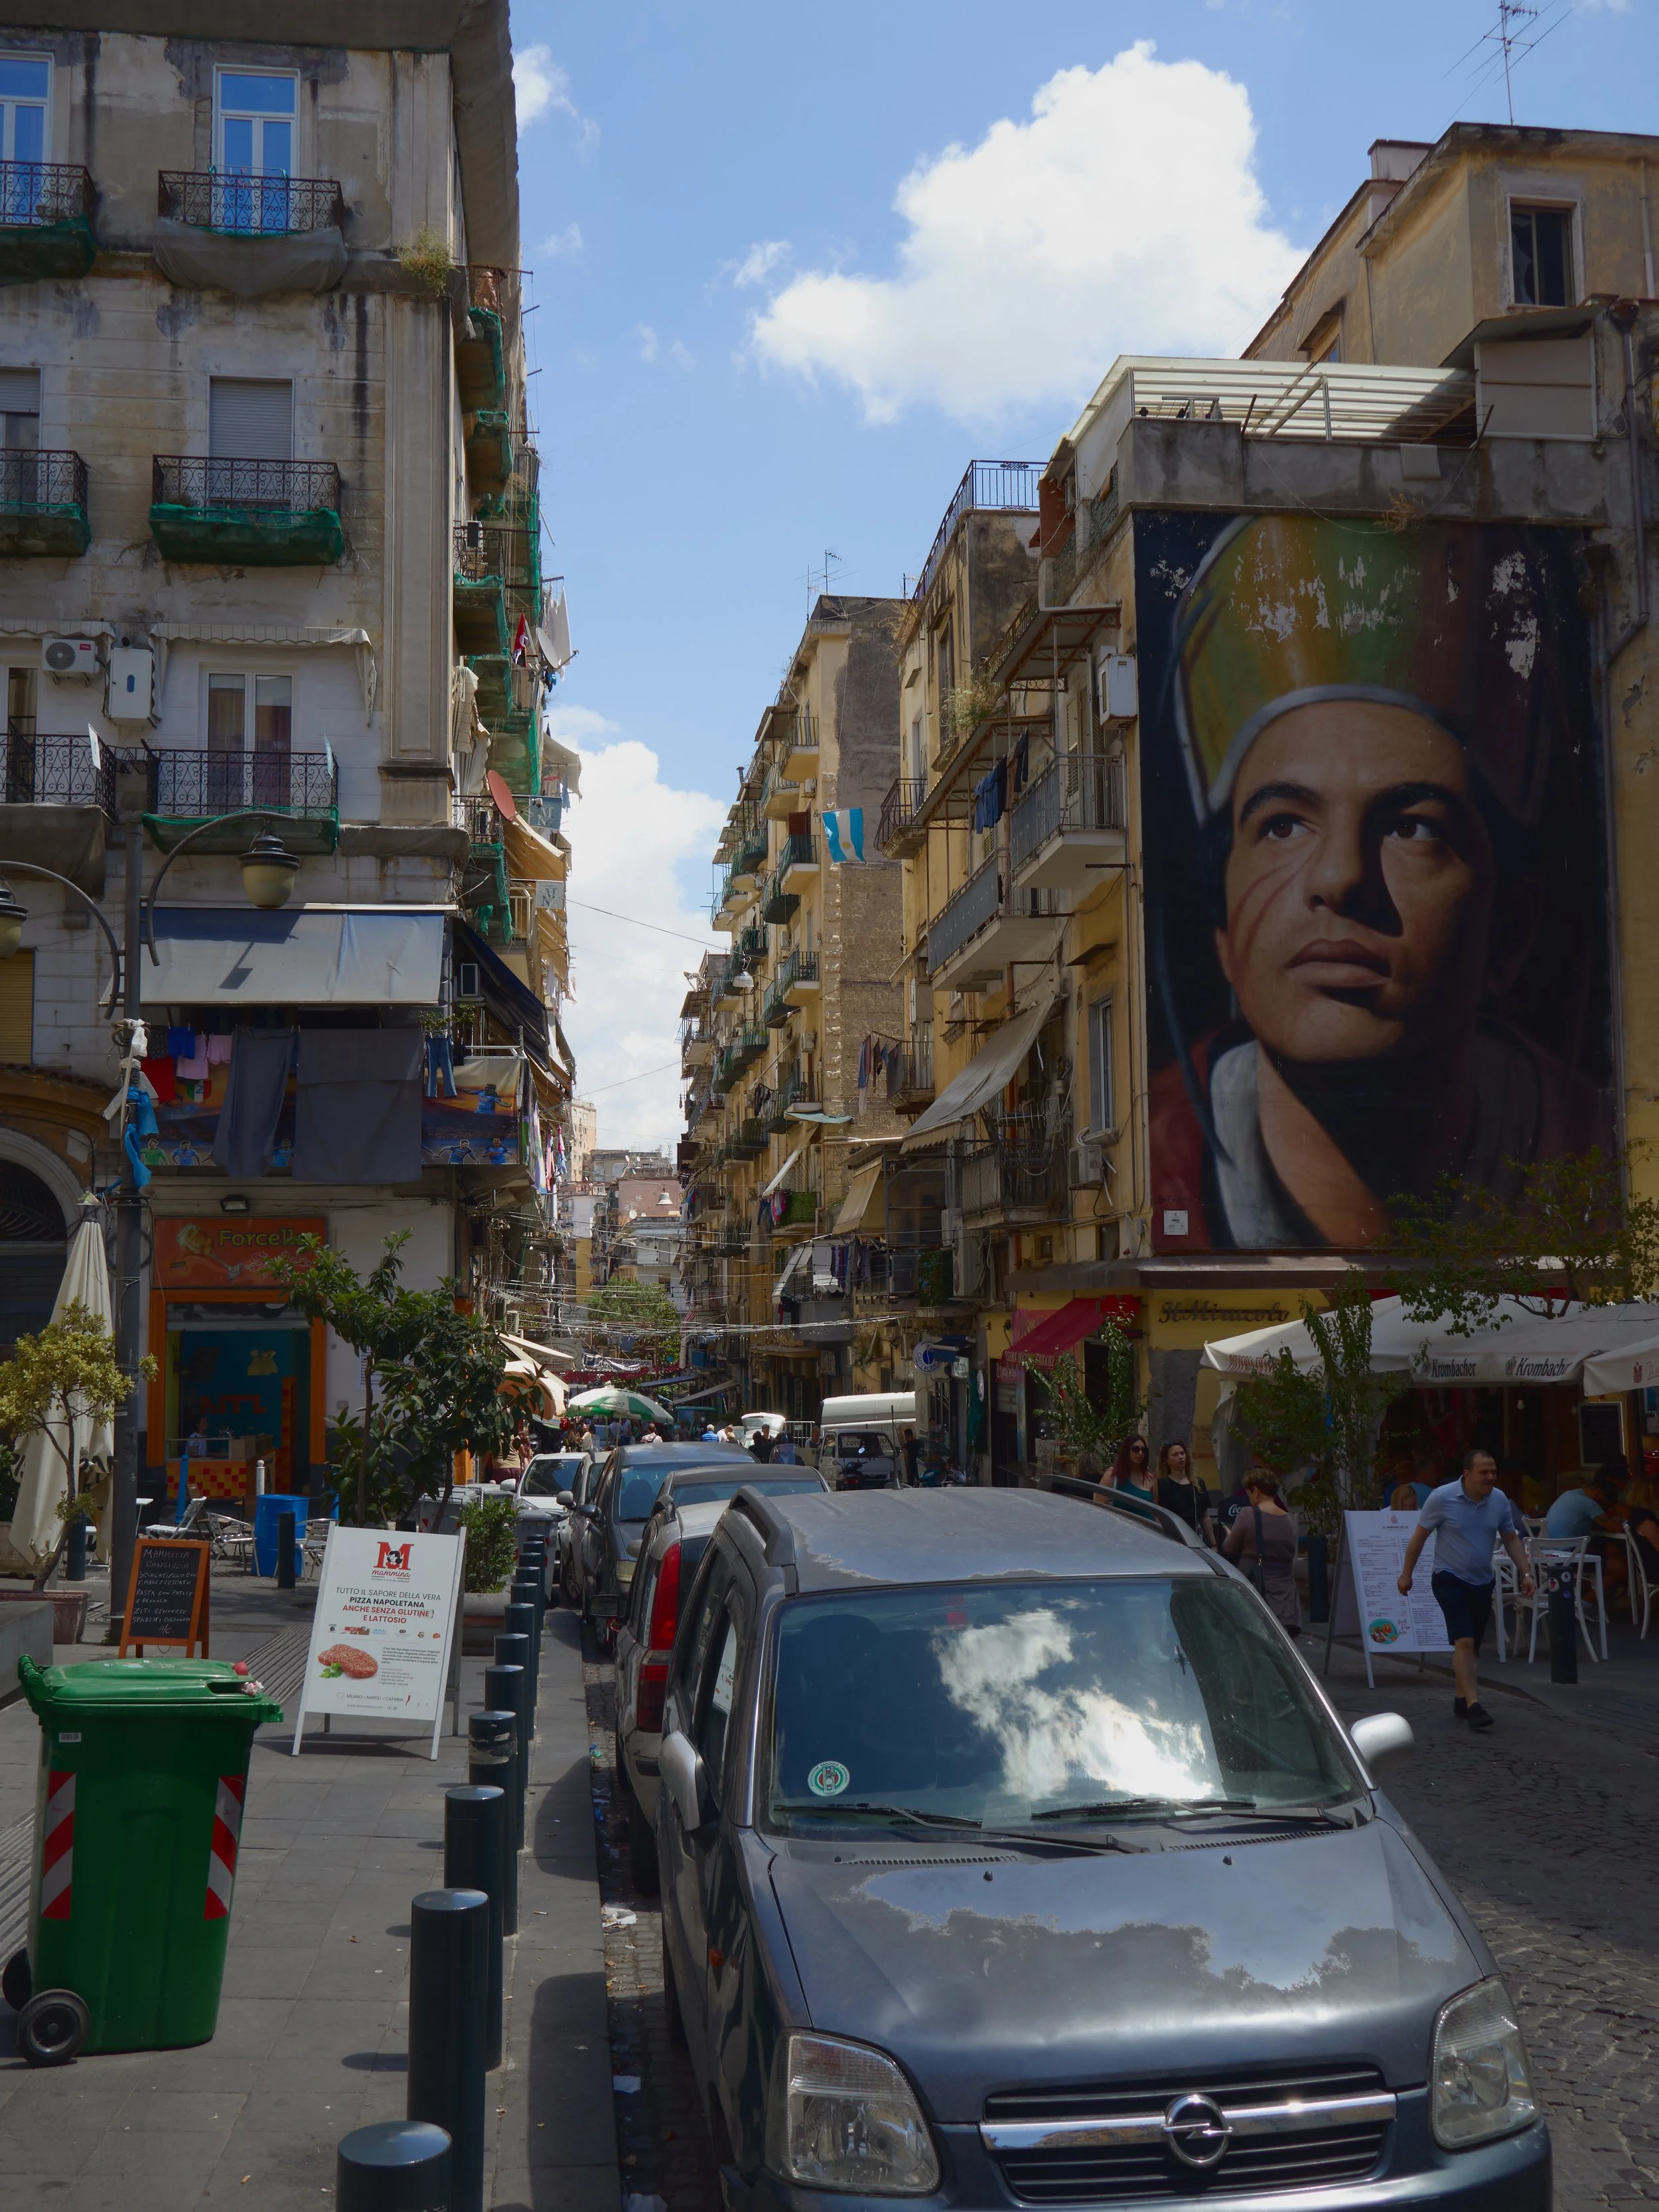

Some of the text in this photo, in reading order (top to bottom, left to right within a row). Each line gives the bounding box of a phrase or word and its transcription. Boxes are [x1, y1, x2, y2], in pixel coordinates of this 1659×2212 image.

[1159, 1300, 1289, 1323] Il Miracolo
[1431, 1358, 1476, 1377] Krombacher
[372, 1569, 411, 1578] mammina
[373, 1598, 424, 1608] NAPOLETANA
[369, 1615, 407, 1624] LATTOSIO
